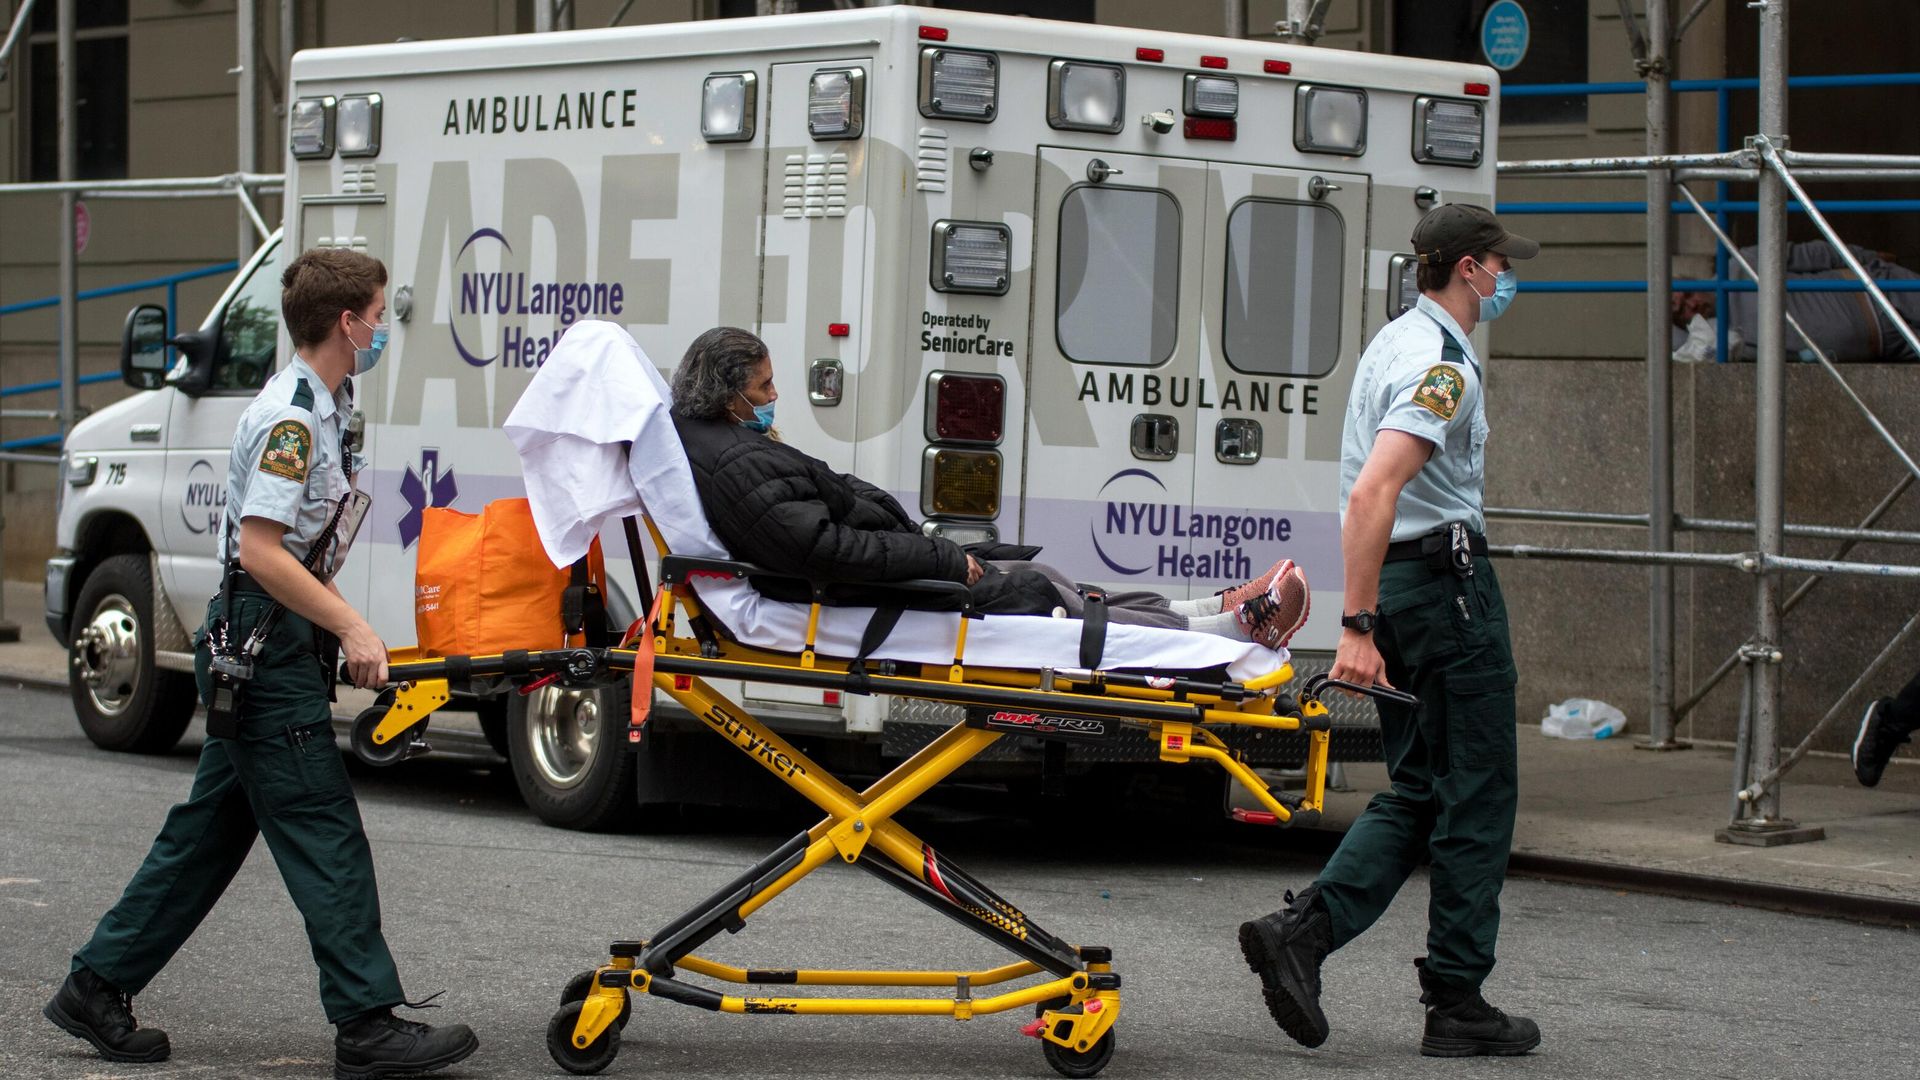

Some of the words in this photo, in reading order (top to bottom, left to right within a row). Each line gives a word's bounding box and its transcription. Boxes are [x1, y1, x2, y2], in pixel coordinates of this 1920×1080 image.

[443, 89, 637, 136] AMBULANCE
[461, 272, 512, 315] NYU
[517, 272, 624, 325] Langone
[922, 311, 975, 328] Operated
[976, 314, 991, 333] by
[921, 330, 1014, 357] SeniorCare
[1077, 370, 1319, 415] AMBULANCE
[105, 463, 127, 485] 715
[186, 483, 215, 506] NYU
[1106, 501, 1167, 536] NYU
[1173, 505, 1291, 546] Langone
[1157, 544, 1251, 580] Health
[993, 711, 1103, 731] MX-PRO
